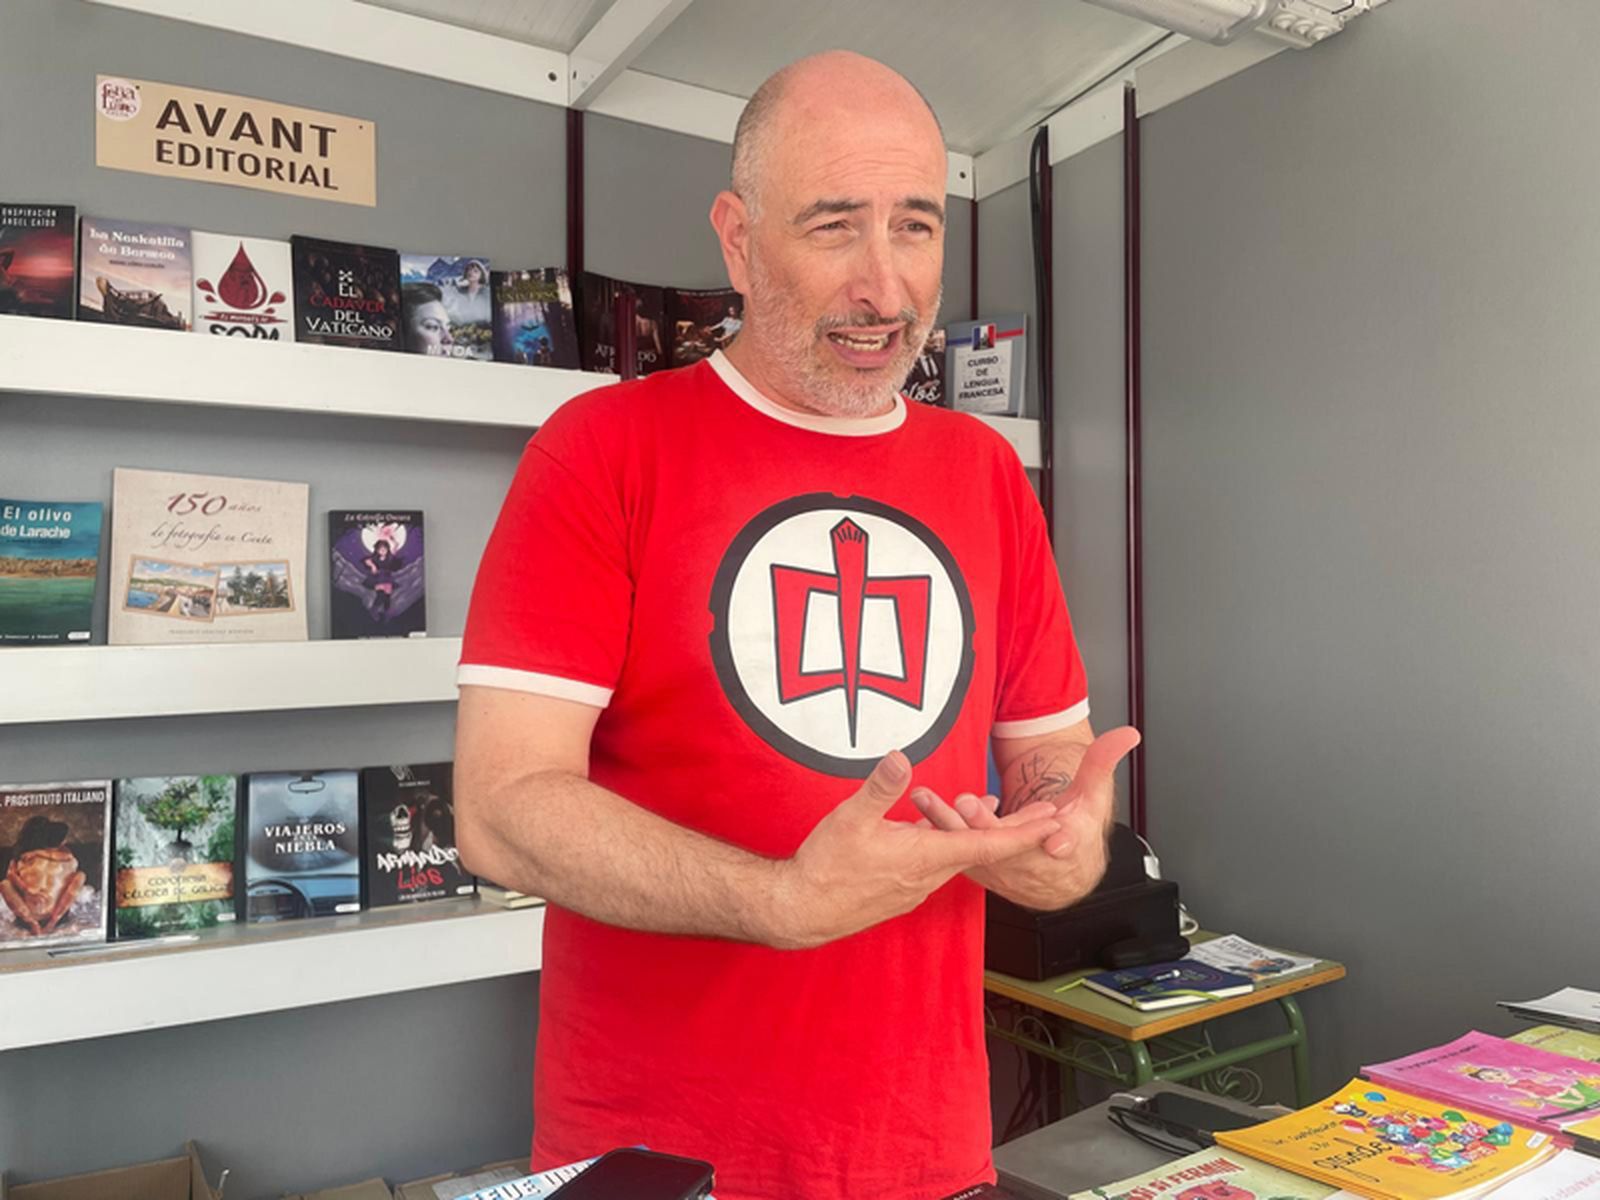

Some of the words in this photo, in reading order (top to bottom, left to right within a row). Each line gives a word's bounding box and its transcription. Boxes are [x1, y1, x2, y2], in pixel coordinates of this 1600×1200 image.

[155, 98, 338, 159] AVANT
[155, 138, 339, 191] EDITORIAL
[338, 282, 358, 298] EL
[334, 309, 365, 323] DEL
[305, 316, 394, 338] VATICANO
[967, 355, 999, 367] CURSO
[975, 368, 988, 377] DE
[963, 377, 1000, 389] LENGUA
[958, 387, 1005, 400] FRANCESA
[167, 491, 228, 516] 150
[3, 505, 21, 521] El
[27, 508, 73, 523] olivo
[0, 524, 17, 536] de
[19, 525, 72, 539] Larache
[4, 792, 63, 808] PROSTITUTO
[63, 790, 105, 805] ITALIANO
[264, 822, 347, 838] VIAJEROS
[275, 838, 336, 854] NIEBLA
